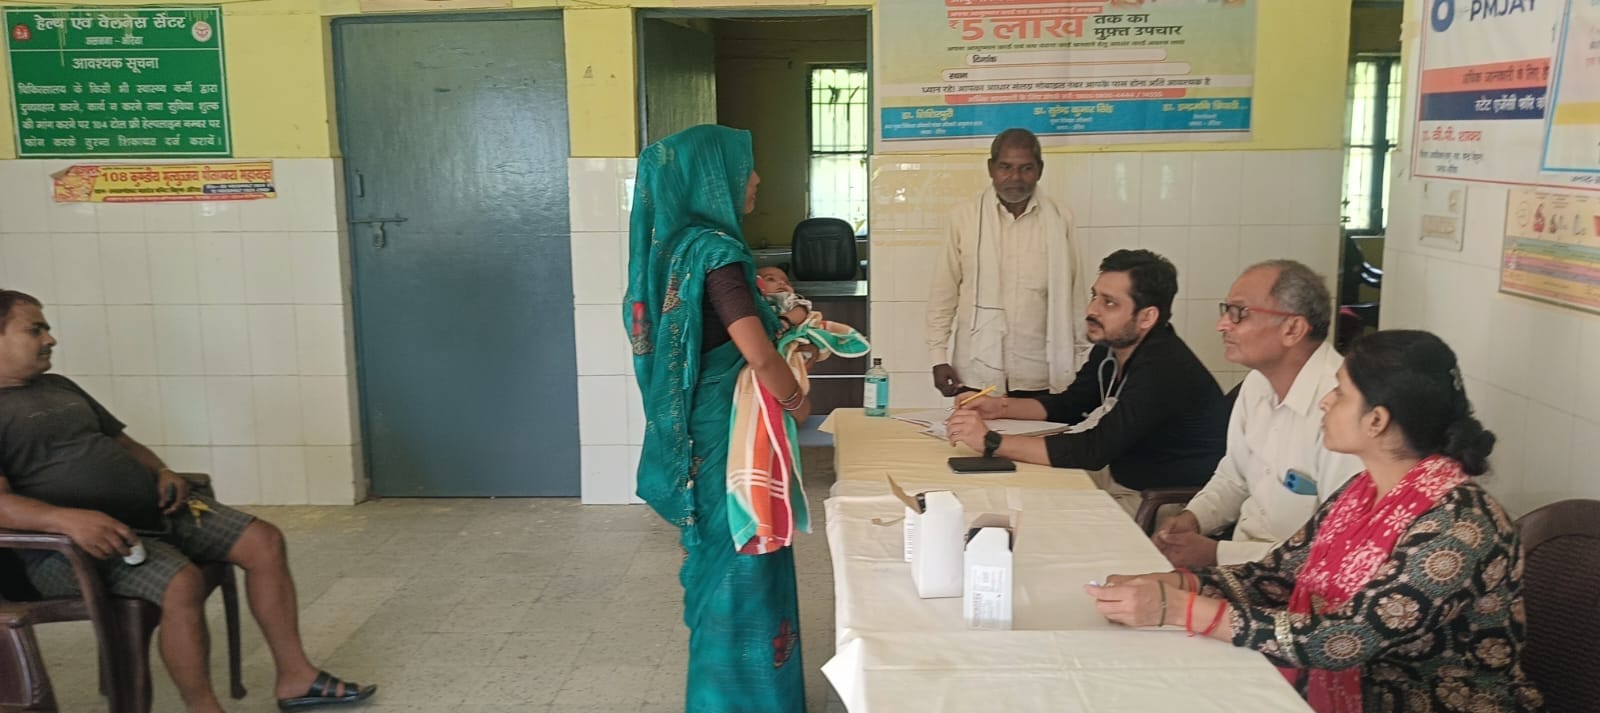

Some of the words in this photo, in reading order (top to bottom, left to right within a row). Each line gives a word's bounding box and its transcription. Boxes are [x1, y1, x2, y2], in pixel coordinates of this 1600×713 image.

[34, 14, 66, 30] हेल्थ
[71, 13, 94, 30] एवं
[98, 14, 149, 29] वेलनेस
[1094, 14, 1123, 24] तक
[1127, 14, 1149, 23] का
[989, 16, 1088, 40] लाख
[1134, 26, 1183, 36] उपचार
[972, 54, 997, 64] दिनांक
[72, 57, 123, 70] आवश्यक
[125, 57, 160, 73] सूचना
[73, 82, 83, 94] के
[102, 172, 129, 182] 108
